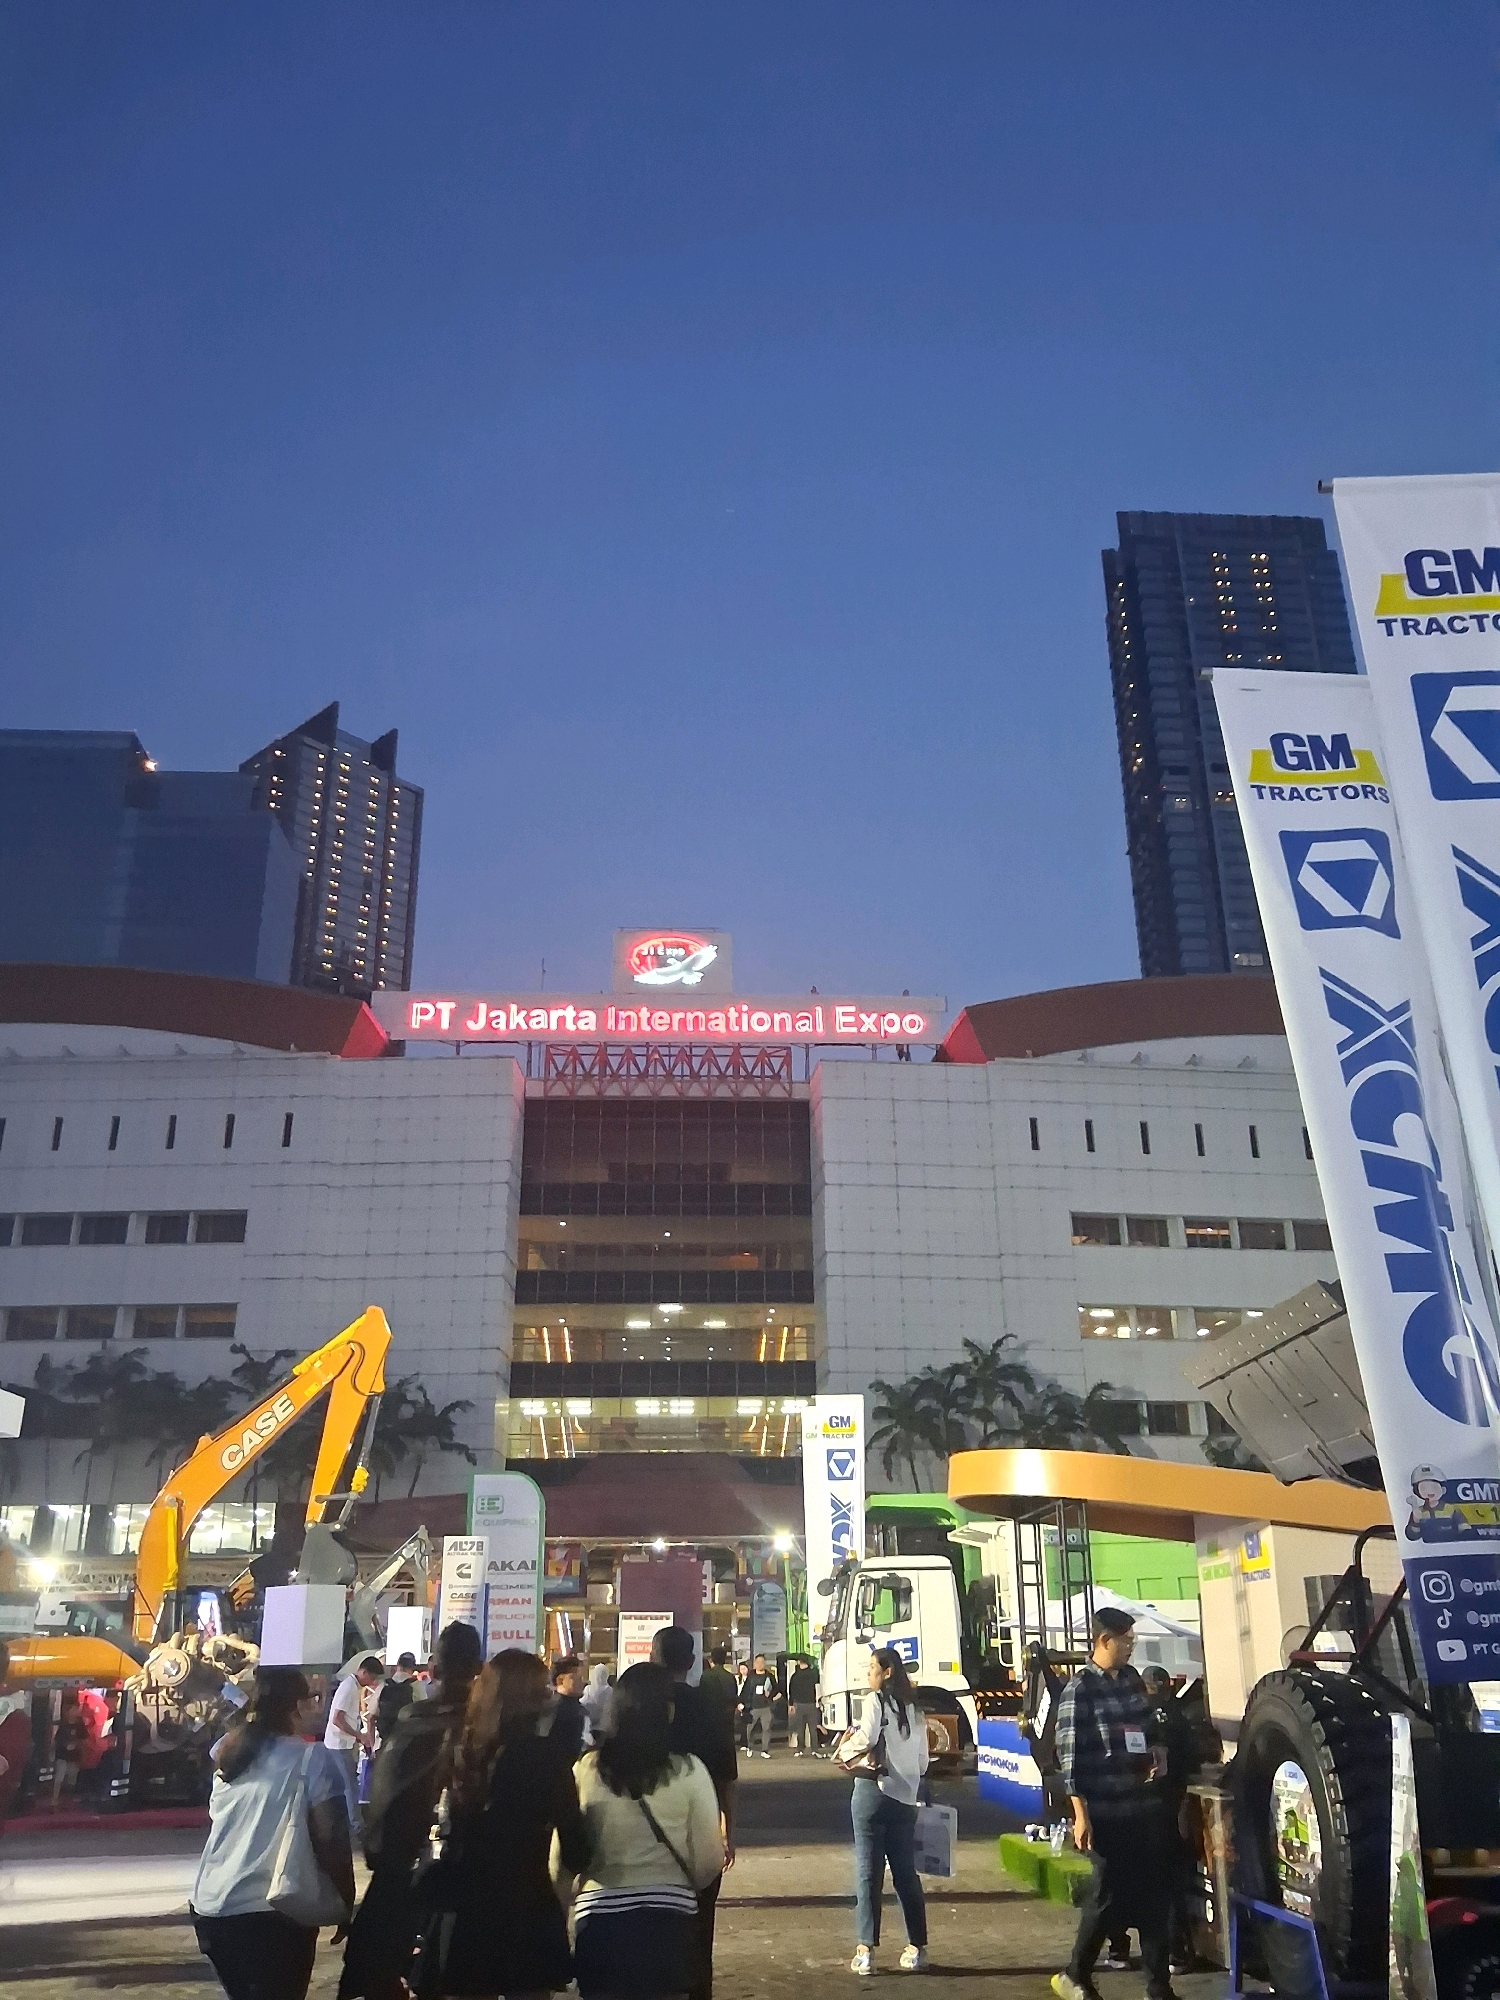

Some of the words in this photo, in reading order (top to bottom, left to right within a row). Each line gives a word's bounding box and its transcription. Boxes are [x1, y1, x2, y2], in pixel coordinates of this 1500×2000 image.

[1269, 732, 1357, 771] GM
[1250, 784, 1390, 804] TRACTORS
[411, 1001, 456, 1030] PT
[466, 1002, 597, 1032] Jakarta
[607, 1004, 824, 1034] International
[835, 1005, 925, 1038] Expo
[1318, 966, 1499, 1428] XCMG
[221, 1392, 295, 1470] CASE
[829, 1415, 851, 1428] GM
[1472, 1643, 1488, 1655] PT
